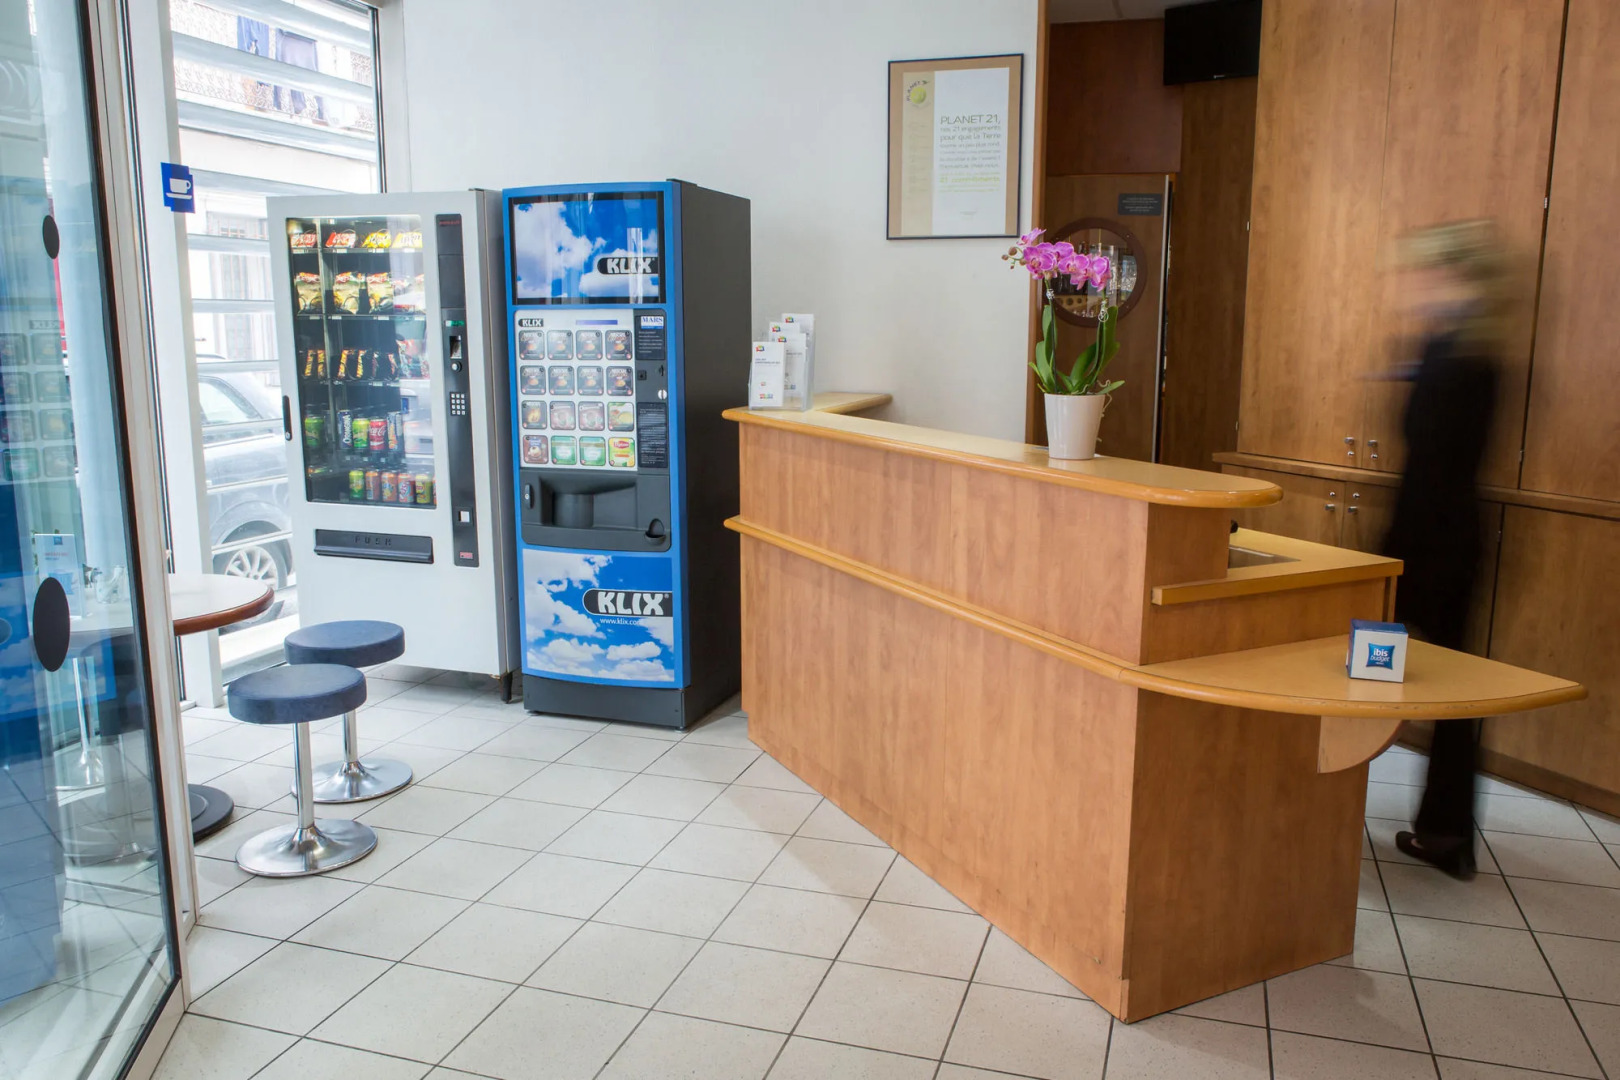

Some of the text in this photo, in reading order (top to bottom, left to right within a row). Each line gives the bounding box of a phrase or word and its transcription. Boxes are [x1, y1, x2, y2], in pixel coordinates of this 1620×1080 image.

[940, 113, 1001, 125] PLANET 21,
[957, 134, 971, 142] que
[606, 257, 652, 273] KLIX
[522, 319, 542, 327] KLIX
[354, 535, 392, 546] PUSH
[597, 591, 664, 616] KLIX
[1373, 648, 1388, 656] ibis
